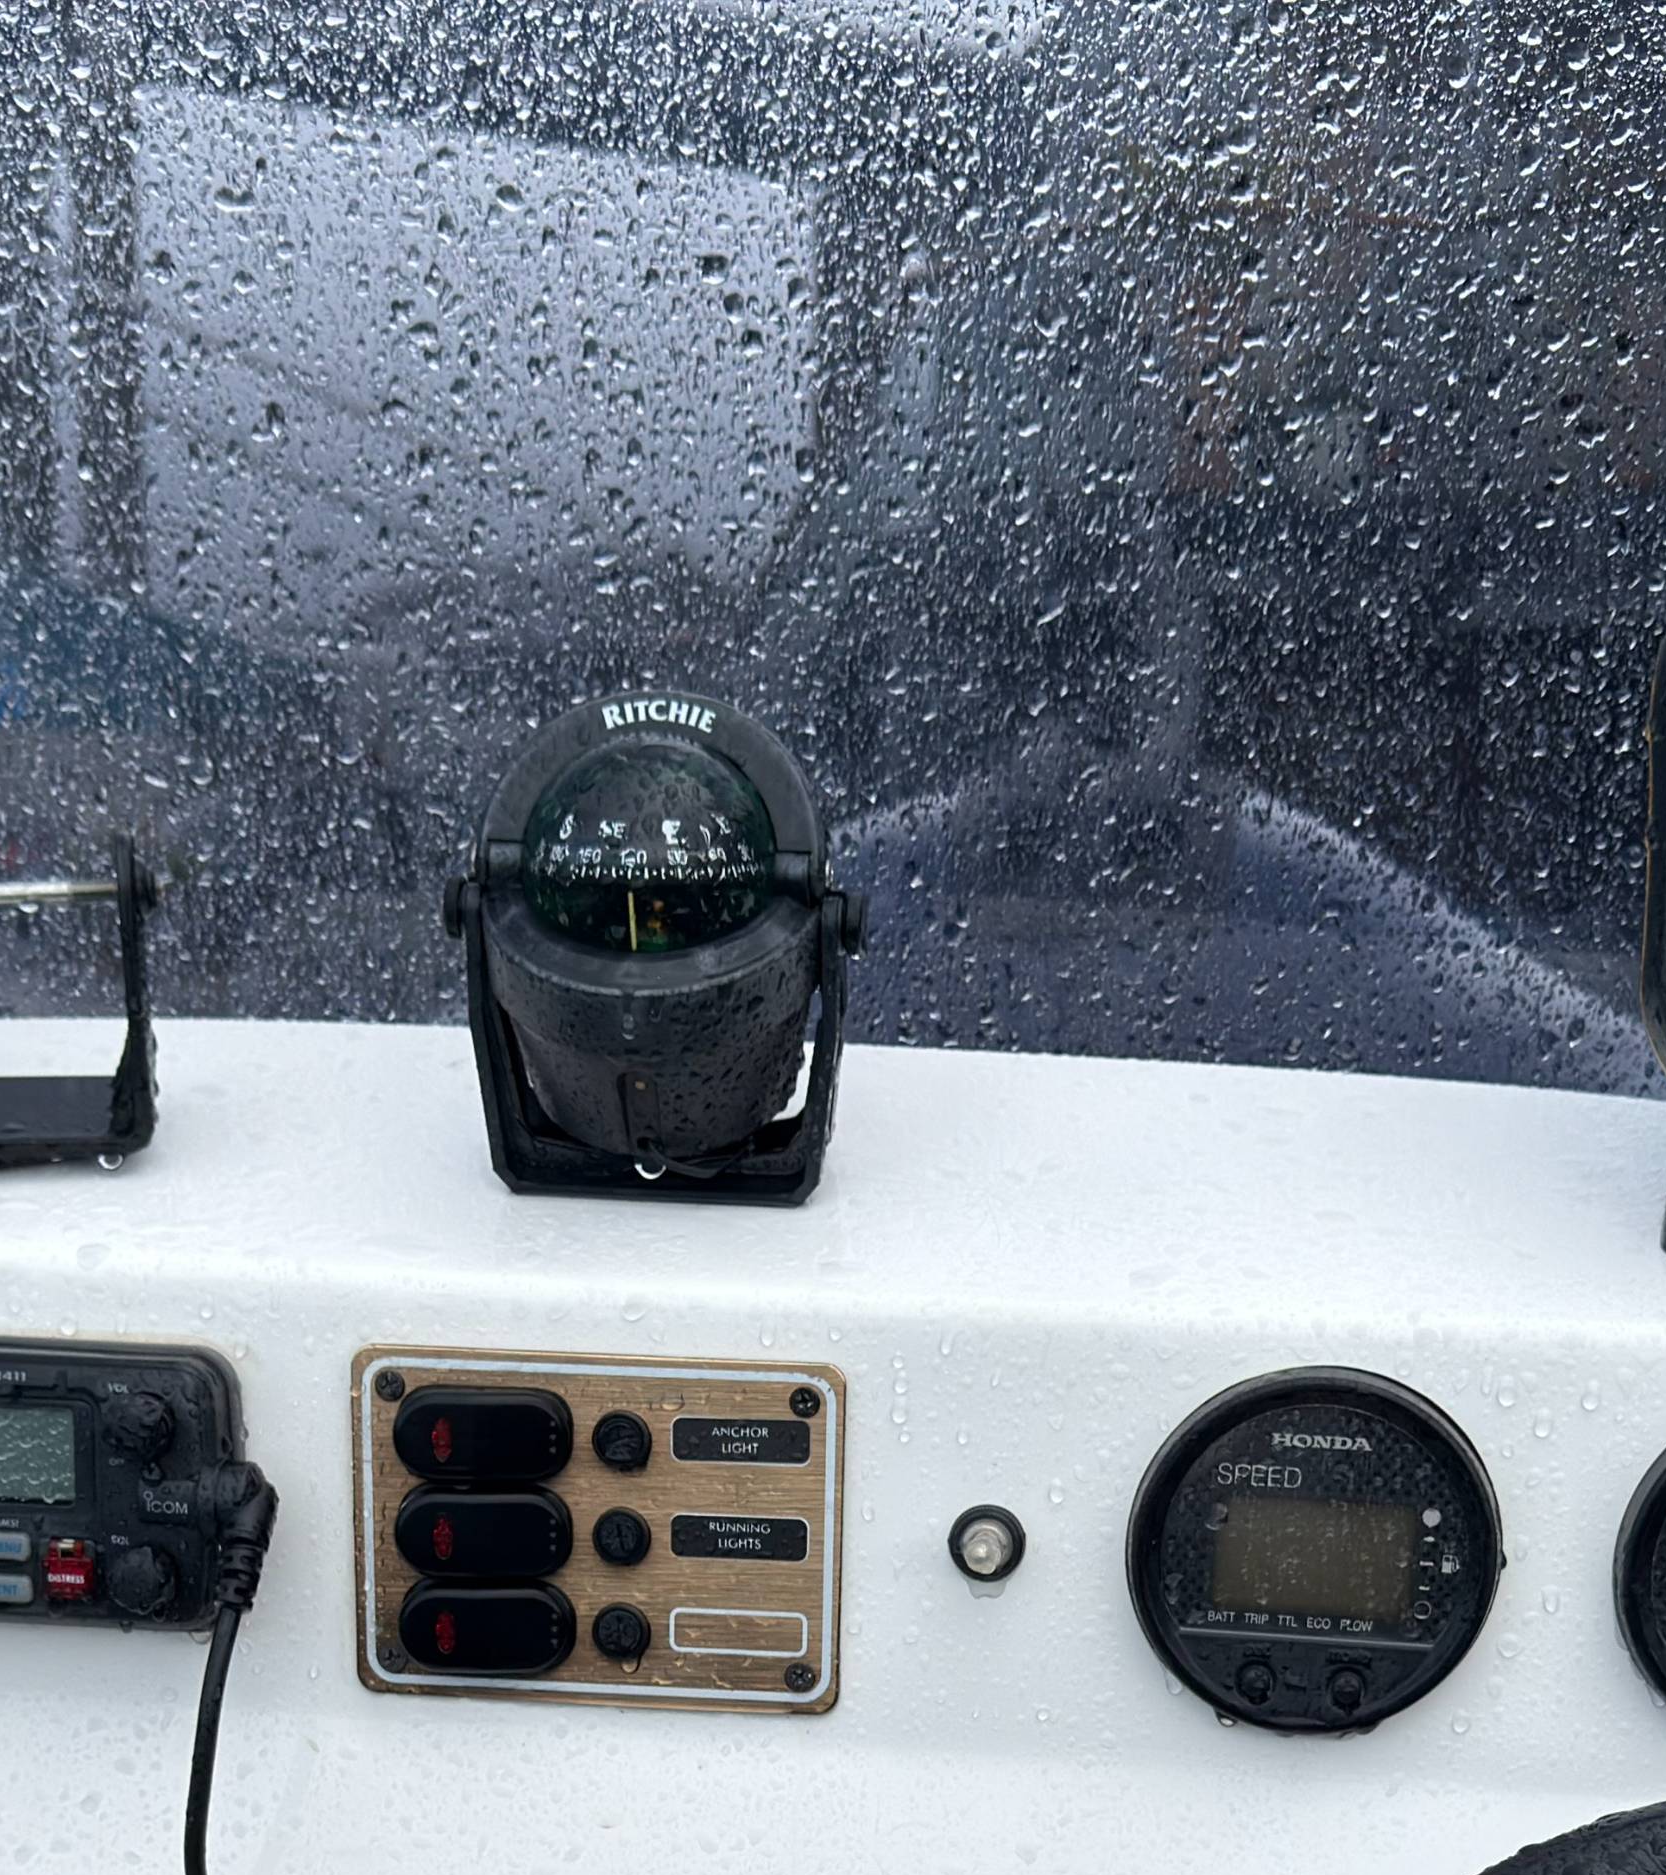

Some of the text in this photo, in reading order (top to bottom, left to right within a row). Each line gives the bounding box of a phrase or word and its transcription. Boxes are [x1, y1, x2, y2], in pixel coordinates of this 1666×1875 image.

[601, 700, 717, 733] RITCHIE
[108, 1382, 130, 1394] VOL
[712, 1425, 770, 1438] ANCHOR
[721, 1441, 759, 1456] LIGHT
[1270, 1432, 1373, 1452] HONDA
[1217, 1462, 1302, 1489] SPEED
[708, 1521, 771, 1535] RUNNING
[717, 1536, 762, 1551] LIGHTS
[47, 1573, 85, 1585] DISTRESS
[1207, 1610, 1373, 1632] BATT TRIP TTL ECO FLOW
